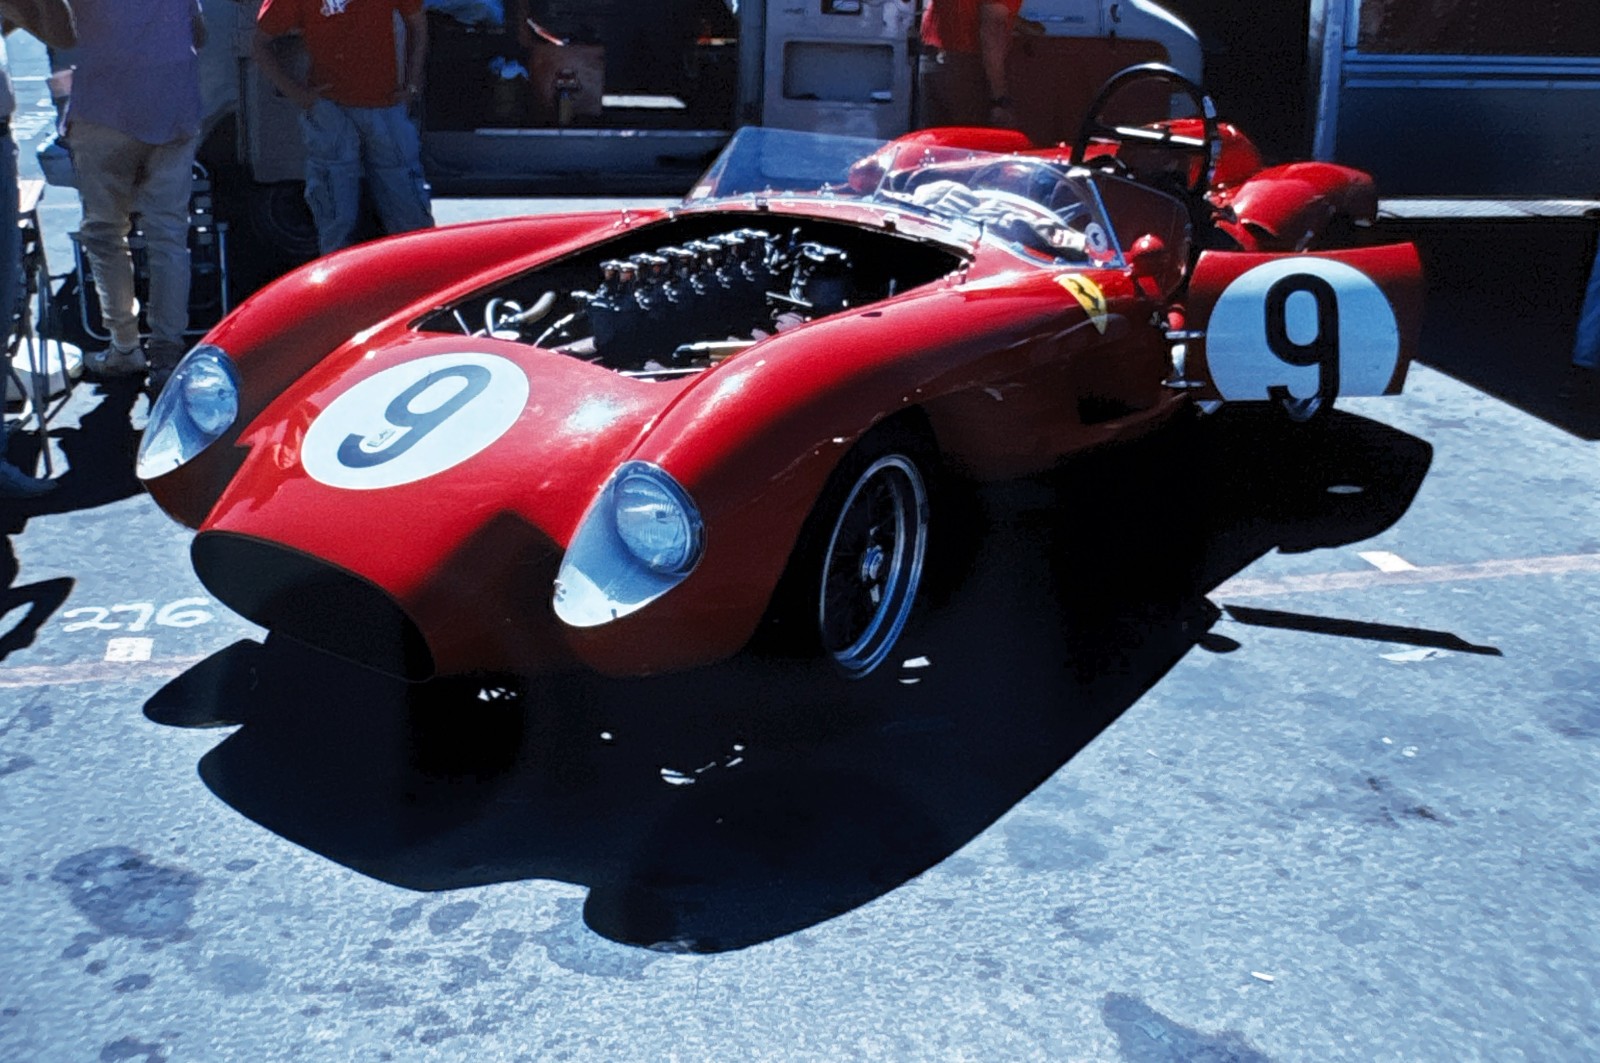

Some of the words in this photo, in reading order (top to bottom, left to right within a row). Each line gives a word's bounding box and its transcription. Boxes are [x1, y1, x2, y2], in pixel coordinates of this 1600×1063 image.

[1265, 272, 1340, 419] 9
[337, 364, 492, 469] 9
[62, 598, 214, 632] 276
